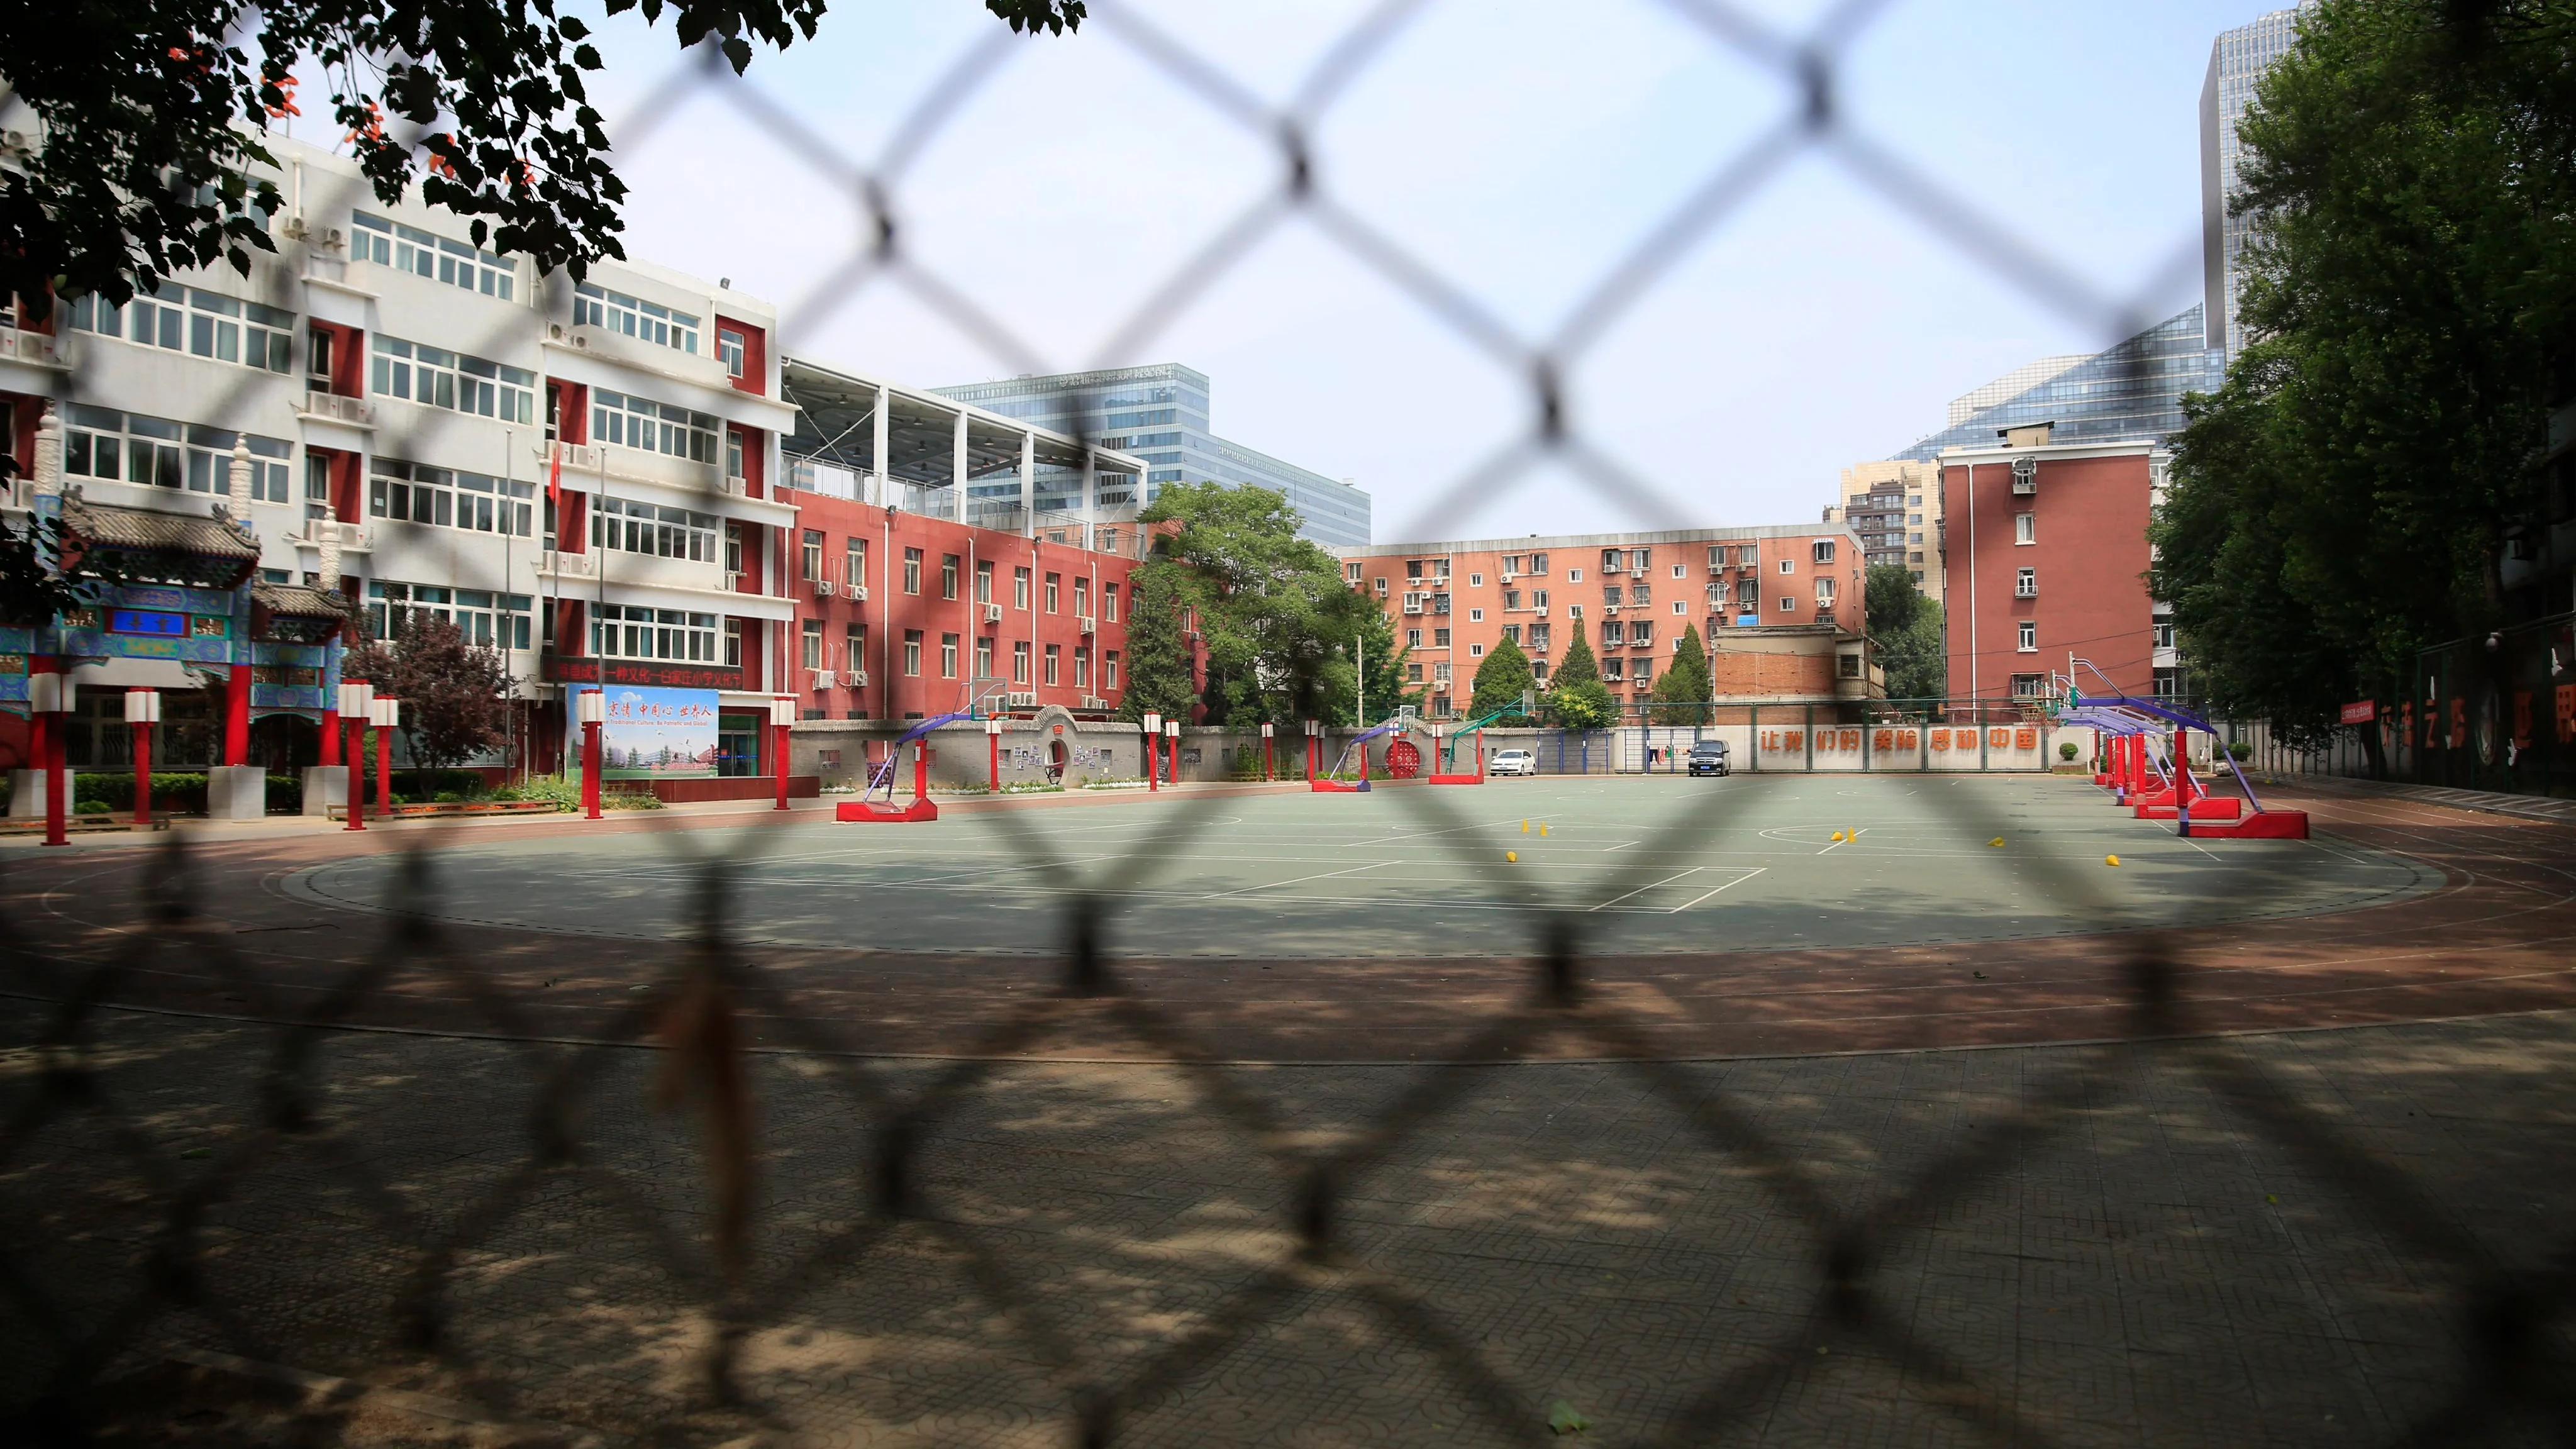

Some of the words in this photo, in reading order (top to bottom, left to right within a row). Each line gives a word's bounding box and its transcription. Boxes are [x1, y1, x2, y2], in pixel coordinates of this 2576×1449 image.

[1135, 369, 1174, 379] RESIDENCE
[639, 702, 674, 718] 中国心
[680, 704, 712, 719] 世界人
[1760, 728, 2036, 751] 让我们的笑脸感动中国
